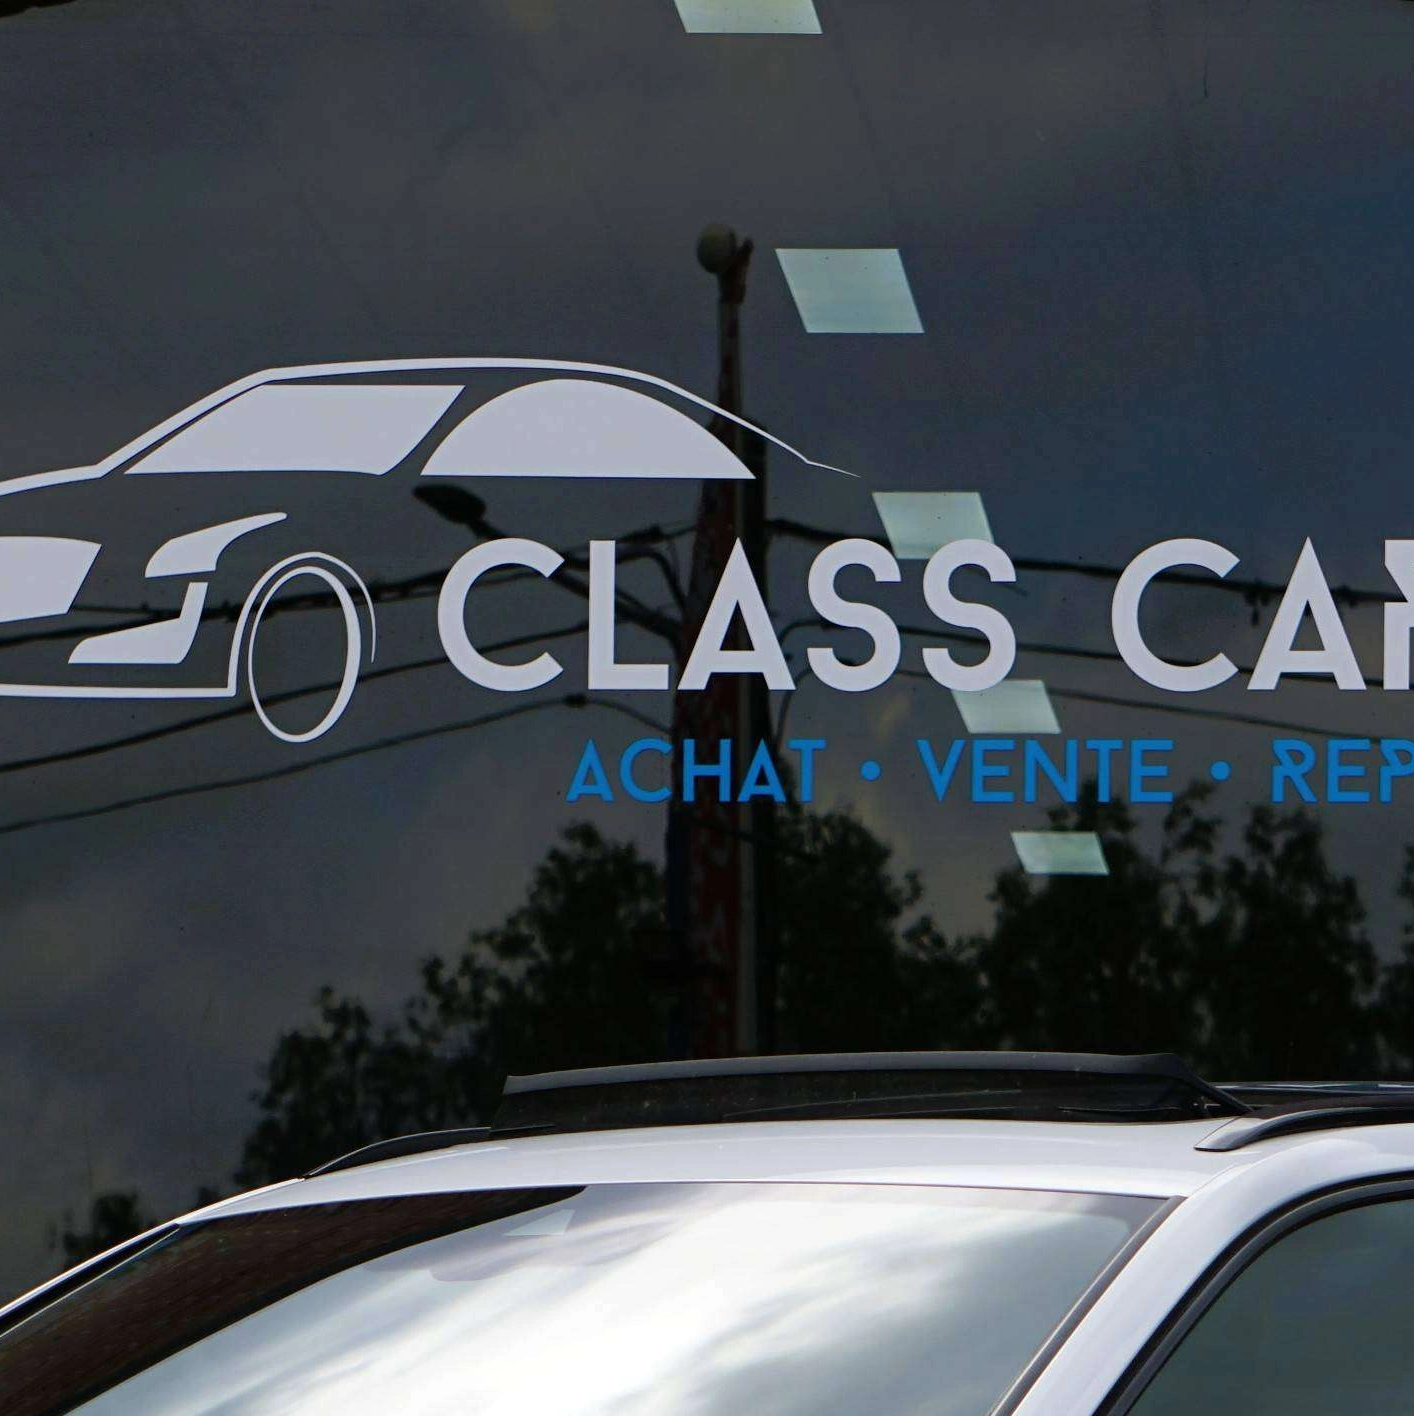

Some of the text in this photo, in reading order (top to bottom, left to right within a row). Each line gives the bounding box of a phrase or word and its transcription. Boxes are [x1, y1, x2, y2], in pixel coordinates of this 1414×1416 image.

[437, 537, 1017, 692] CLASS
[567, 738, 826, 804] ACHAT
[916, 738, 1175, 804] VENTE
